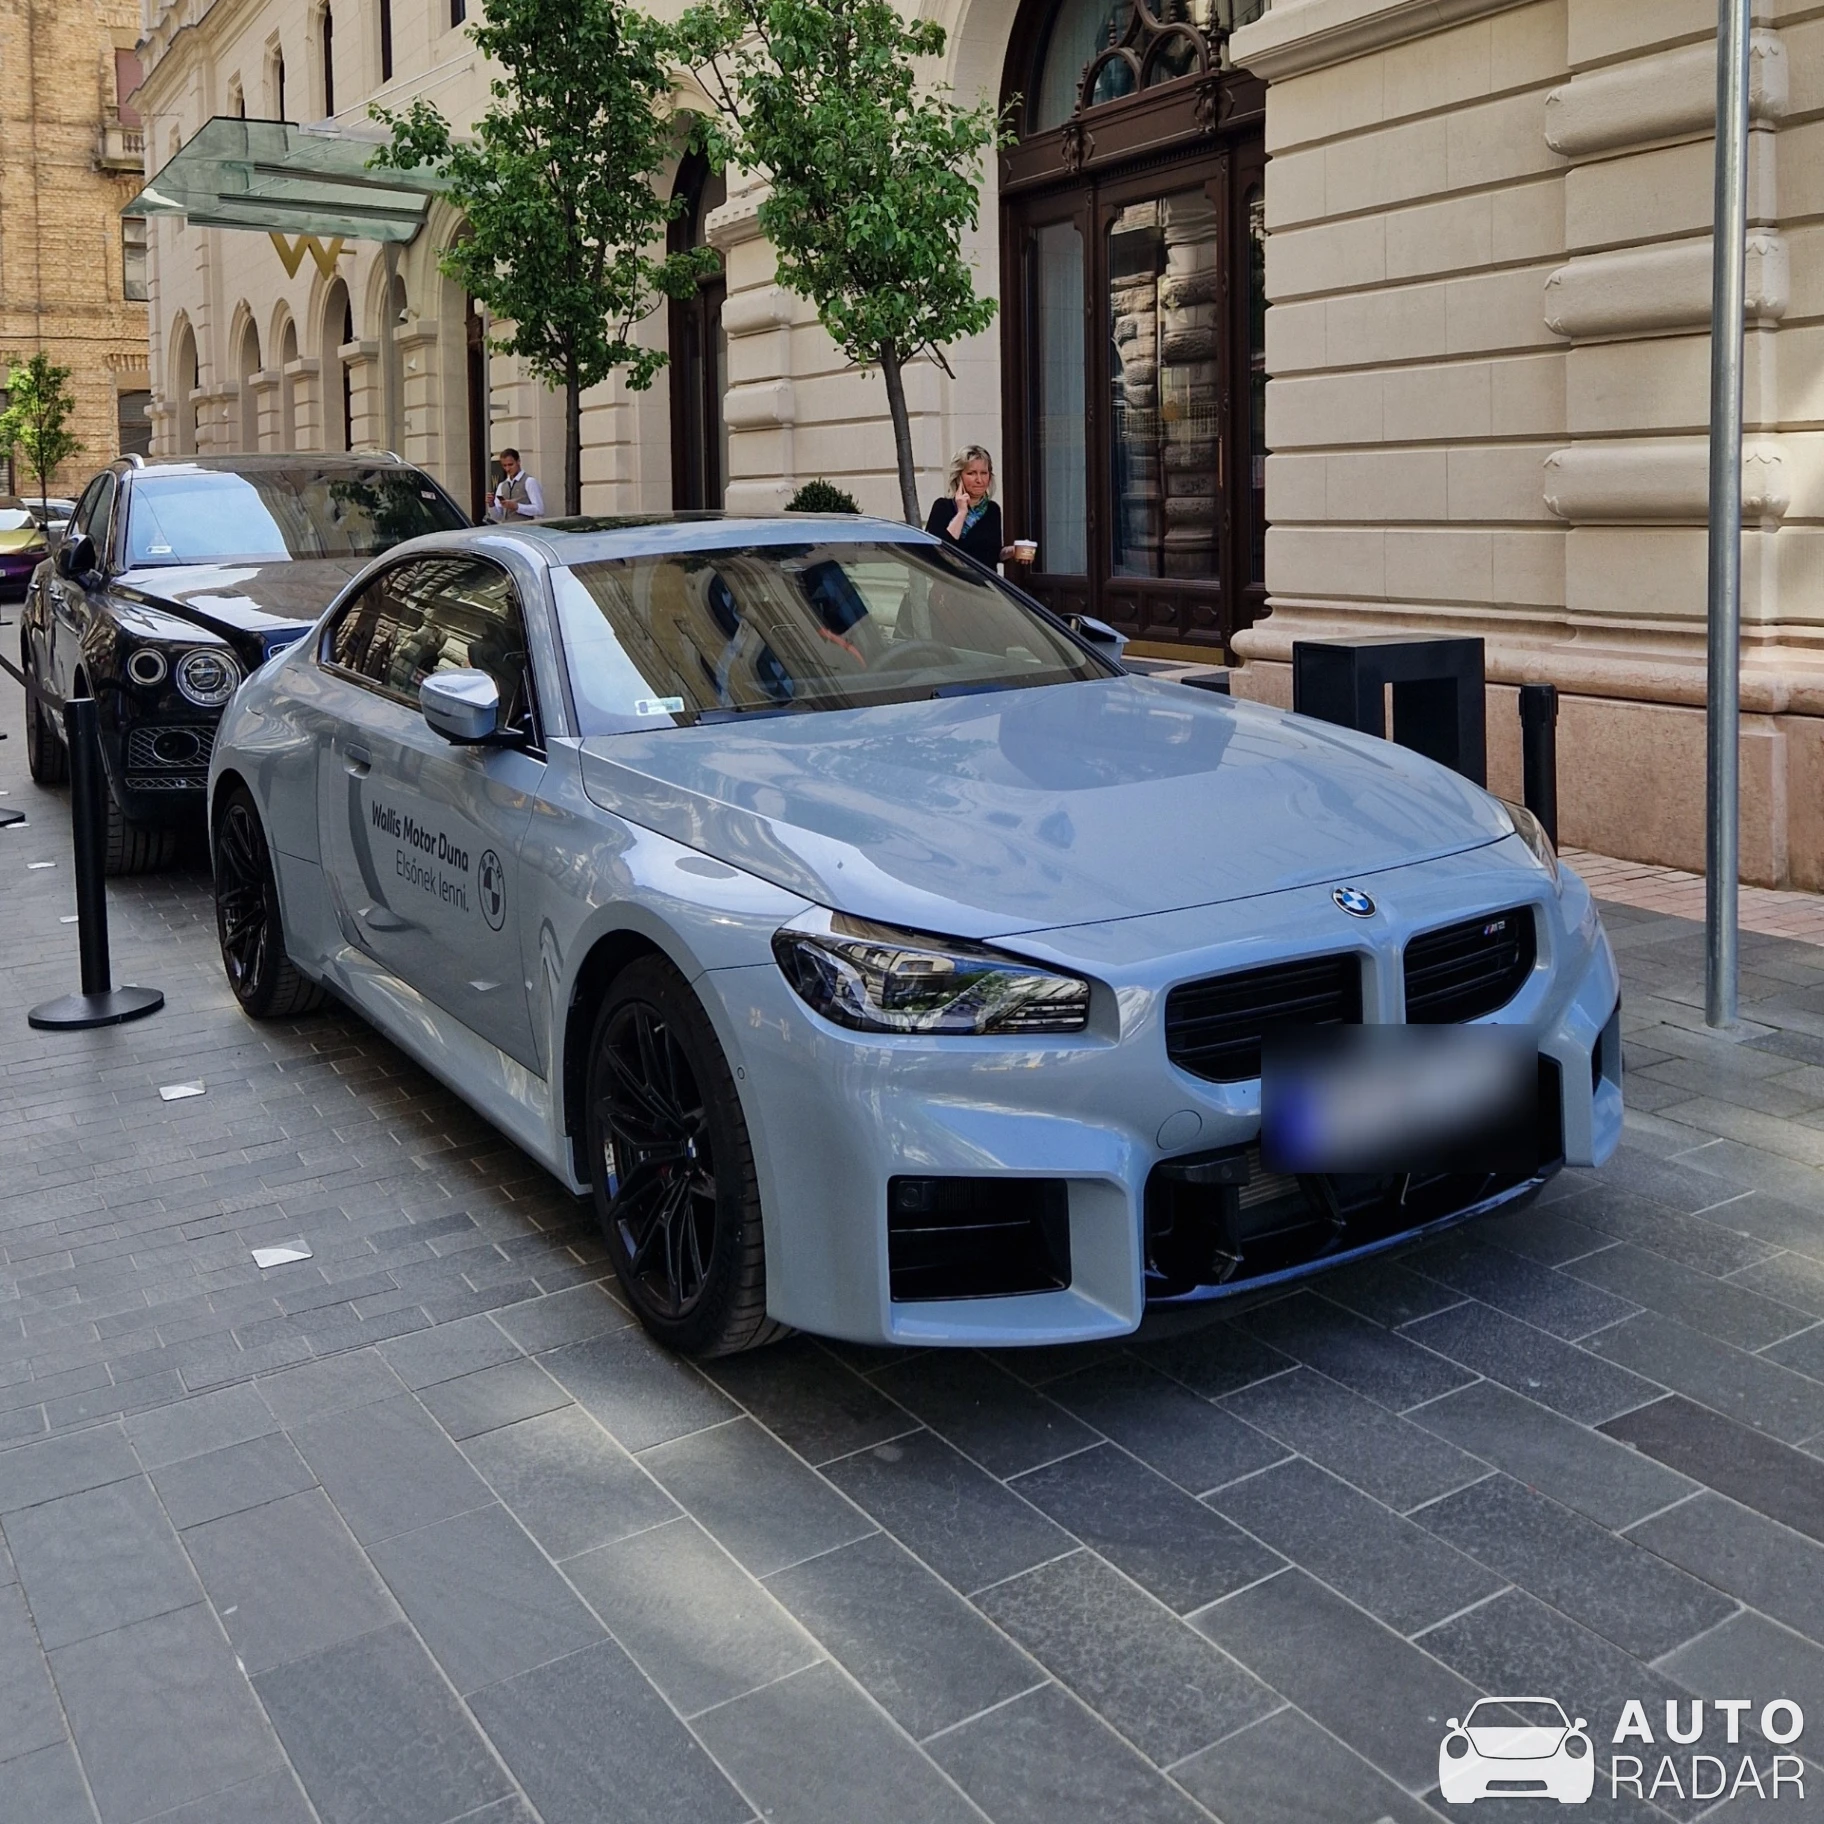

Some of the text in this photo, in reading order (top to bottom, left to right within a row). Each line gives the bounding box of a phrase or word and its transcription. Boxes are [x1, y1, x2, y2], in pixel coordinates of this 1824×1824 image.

[268, 231, 346, 280] W
[372, 800, 469, 873] Wallis Motor Duna
[439, 871, 469, 912] lenni.
